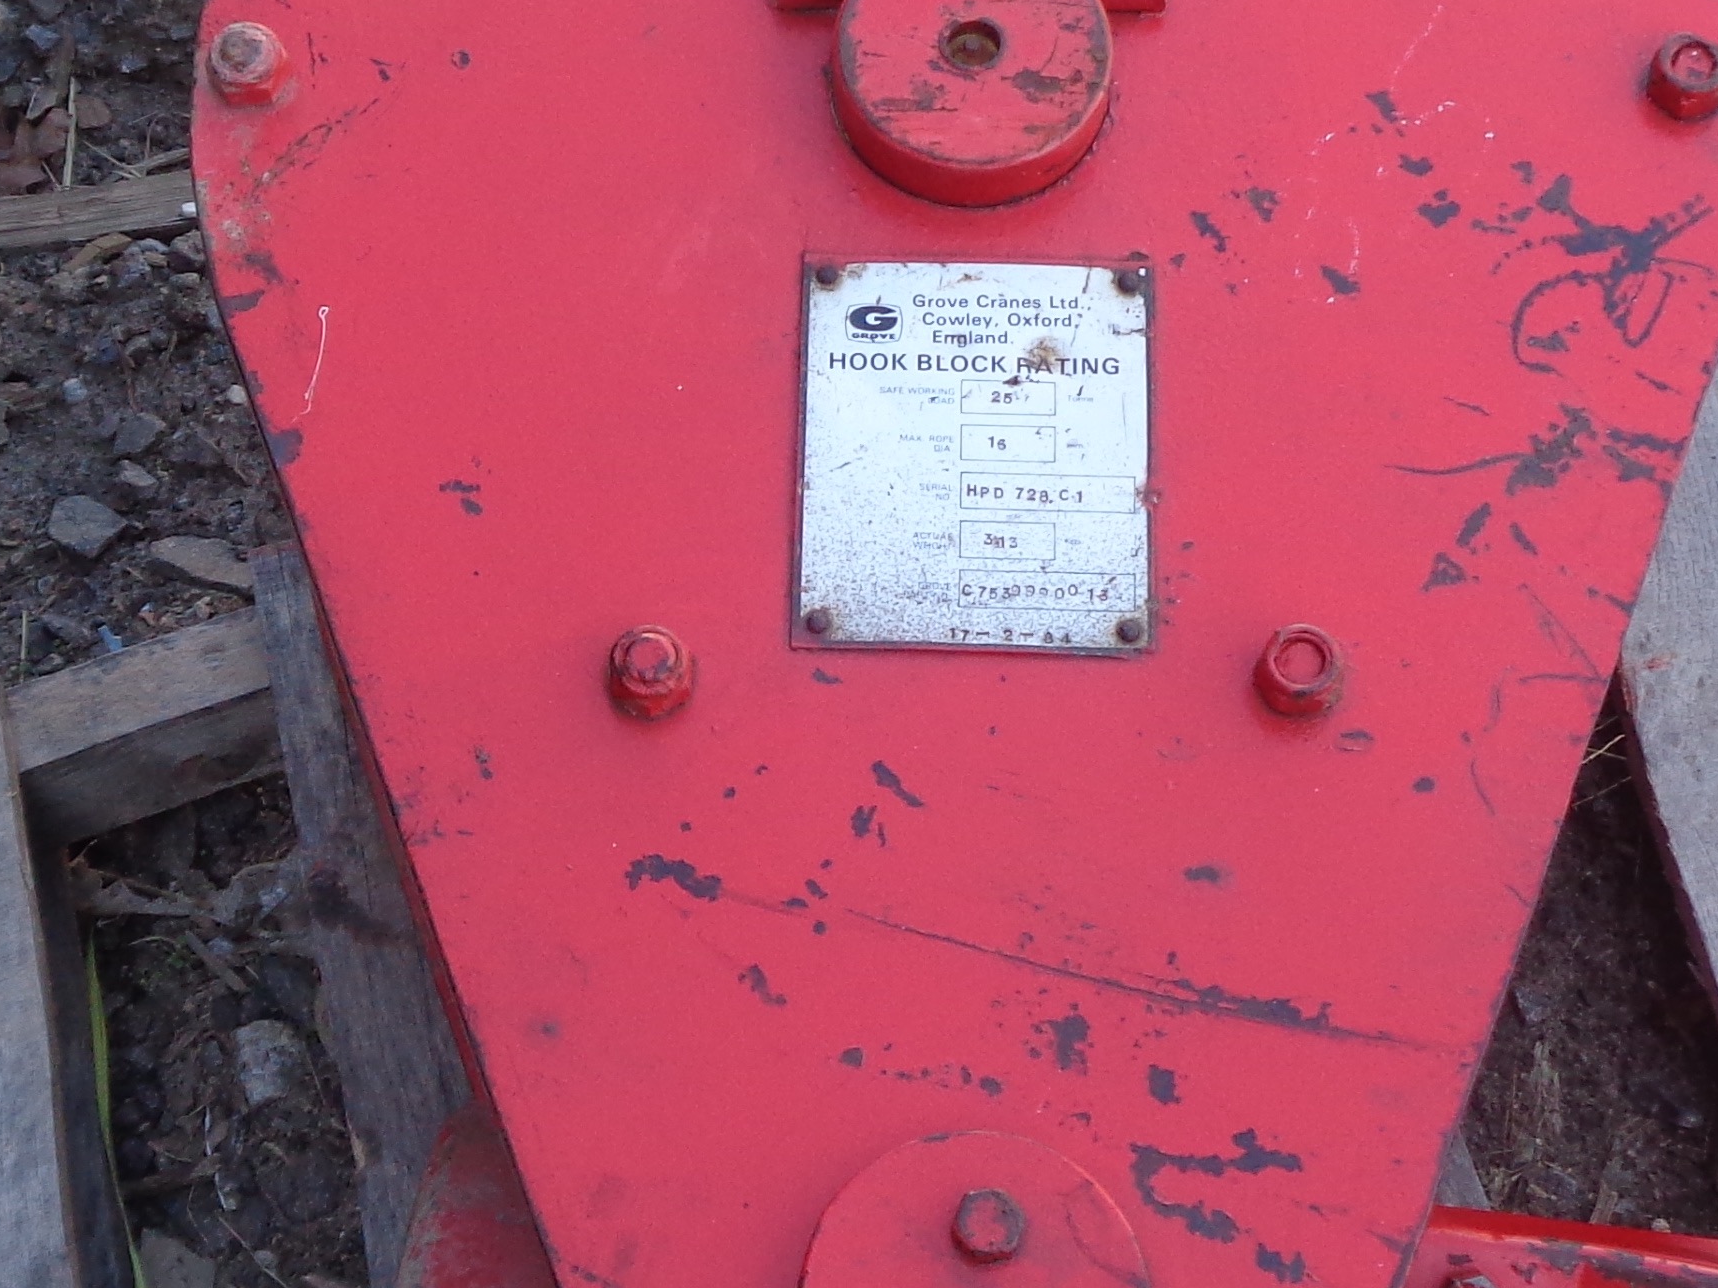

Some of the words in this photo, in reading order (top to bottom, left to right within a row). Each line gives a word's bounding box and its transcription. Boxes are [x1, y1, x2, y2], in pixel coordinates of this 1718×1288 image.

[912, 294, 969, 309] Grove
[976, 294, 1042, 310] Cranes
[922, 312, 999, 329] Cowley,
[851, 332, 896, 341] GROVE
[829, 352, 909, 371] HOOK
[917, 354, 1007, 373] BLOCK
[1016, 356, 1120, 376] RATING
[991, 391, 1013, 405] 25
[987, 435, 1007, 451] 16
[918, 482, 953, 492] SERIAL
[966, 483, 1004, 499] HPD
